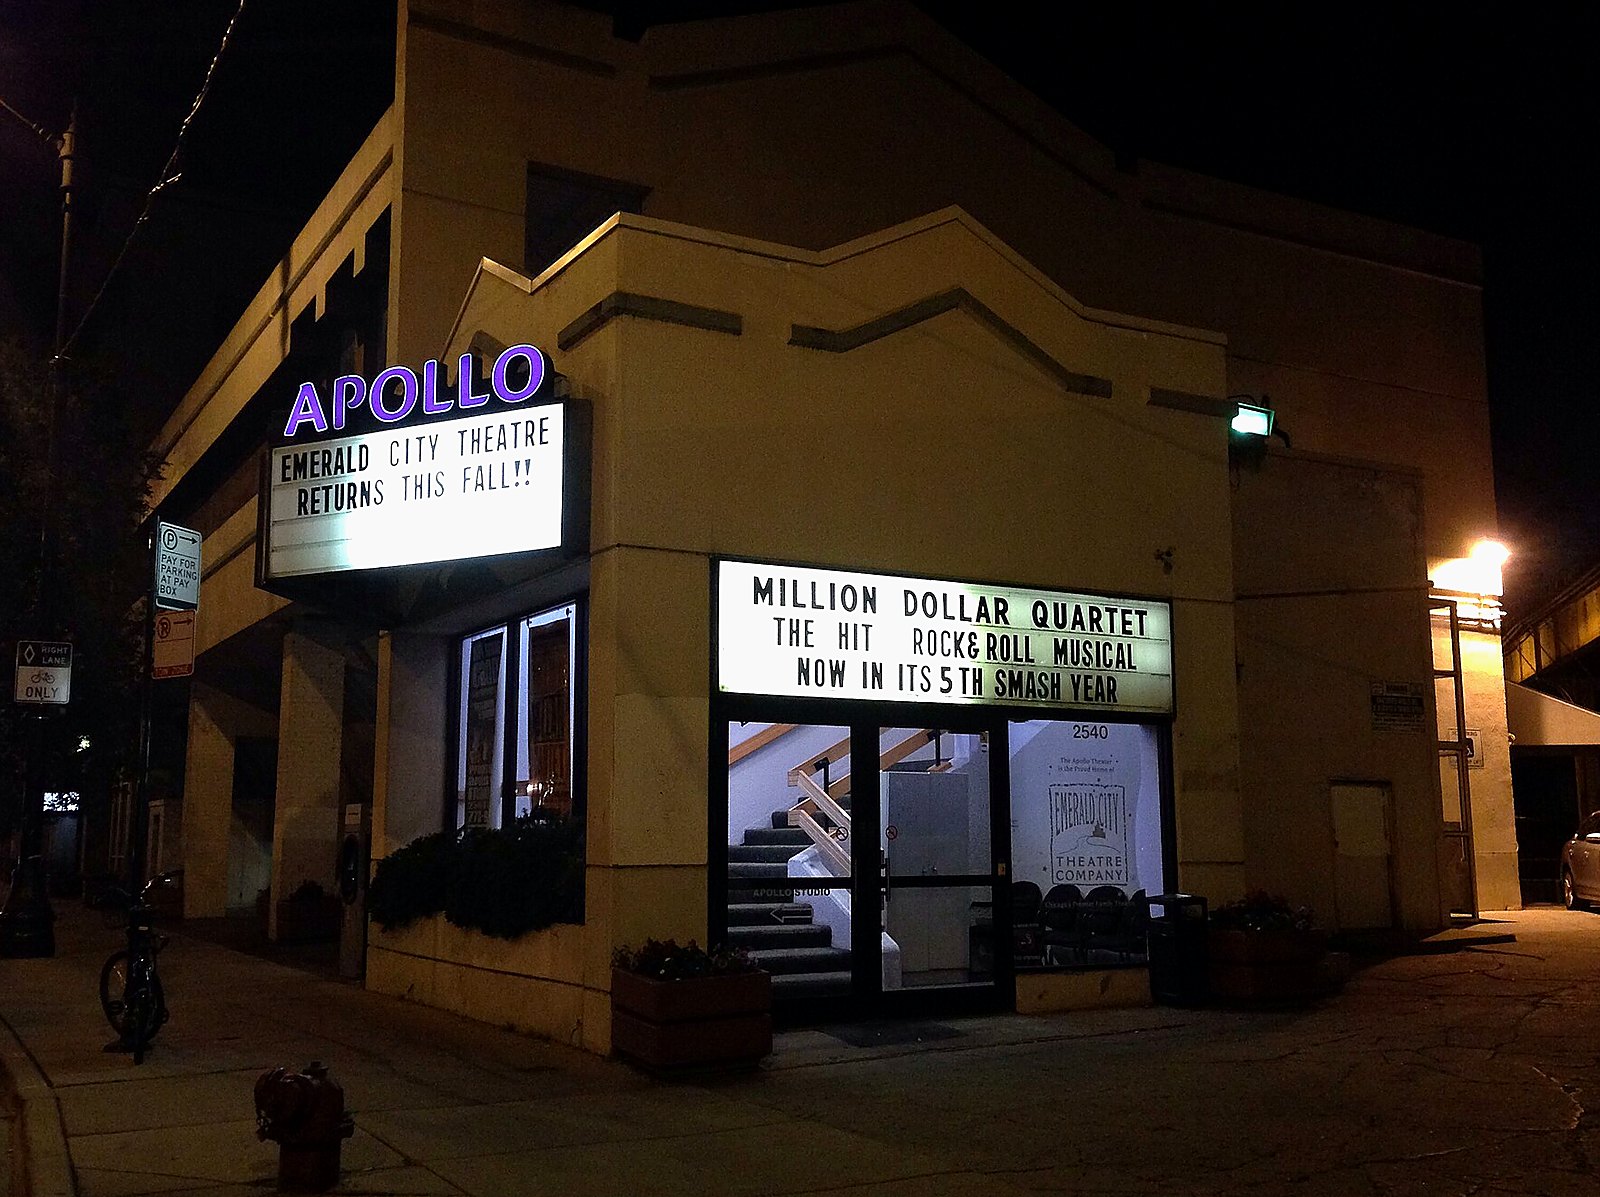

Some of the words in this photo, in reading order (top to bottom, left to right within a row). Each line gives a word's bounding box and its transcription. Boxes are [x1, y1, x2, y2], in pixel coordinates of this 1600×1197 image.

[284, 343, 545, 437] APOLLO
[281, 443, 369, 482] EMERALD
[390, 434, 439, 467] CITY
[458, 417, 549, 457] THEATRE
[297, 480, 384, 516] RETURNS
[402, 471, 445, 501] THIS
[463, 458, 531, 493] FALL!!
[161, 553, 178, 565] PAY
[179, 558, 196, 570] FOR
[161, 564, 197, 581] PARKING
[160, 584, 177, 596] BOX
[161, 575, 171, 585] AT
[173, 579, 190, 589] PAY
[753, 576, 877, 614] MILLION
[904, 589, 1011, 626] DOLLAR
[1031, 600, 1148, 636] QUARTET
[42, 646, 69, 655] RIGHT
[773, 616, 815, 648] THE
[838, 621, 873, 651] HIT
[1053, 637, 1137, 670] MUSICAL
[42, 656, 67, 665] LANE
[797, 657, 846, 688] NOW
[862, 661, 883, 690] IN
[994, 668, 1061, 700] SMASH
[1070, 673, 1118, 704] YEAR
[26, 686, 59, 698] ONLY
[1072, 724, 1108, 739] 2540
[1055, 792, 1096, 836] EMERALD
[1098, 793, 1119, 835] CITY
[1056, 856, 1122, 867] THEATRE
[1056, 869, 1122, 881] COMPANY
[753, 888, 793, 897] APOLLO
[794, 888, 831, 897] STUDIO
